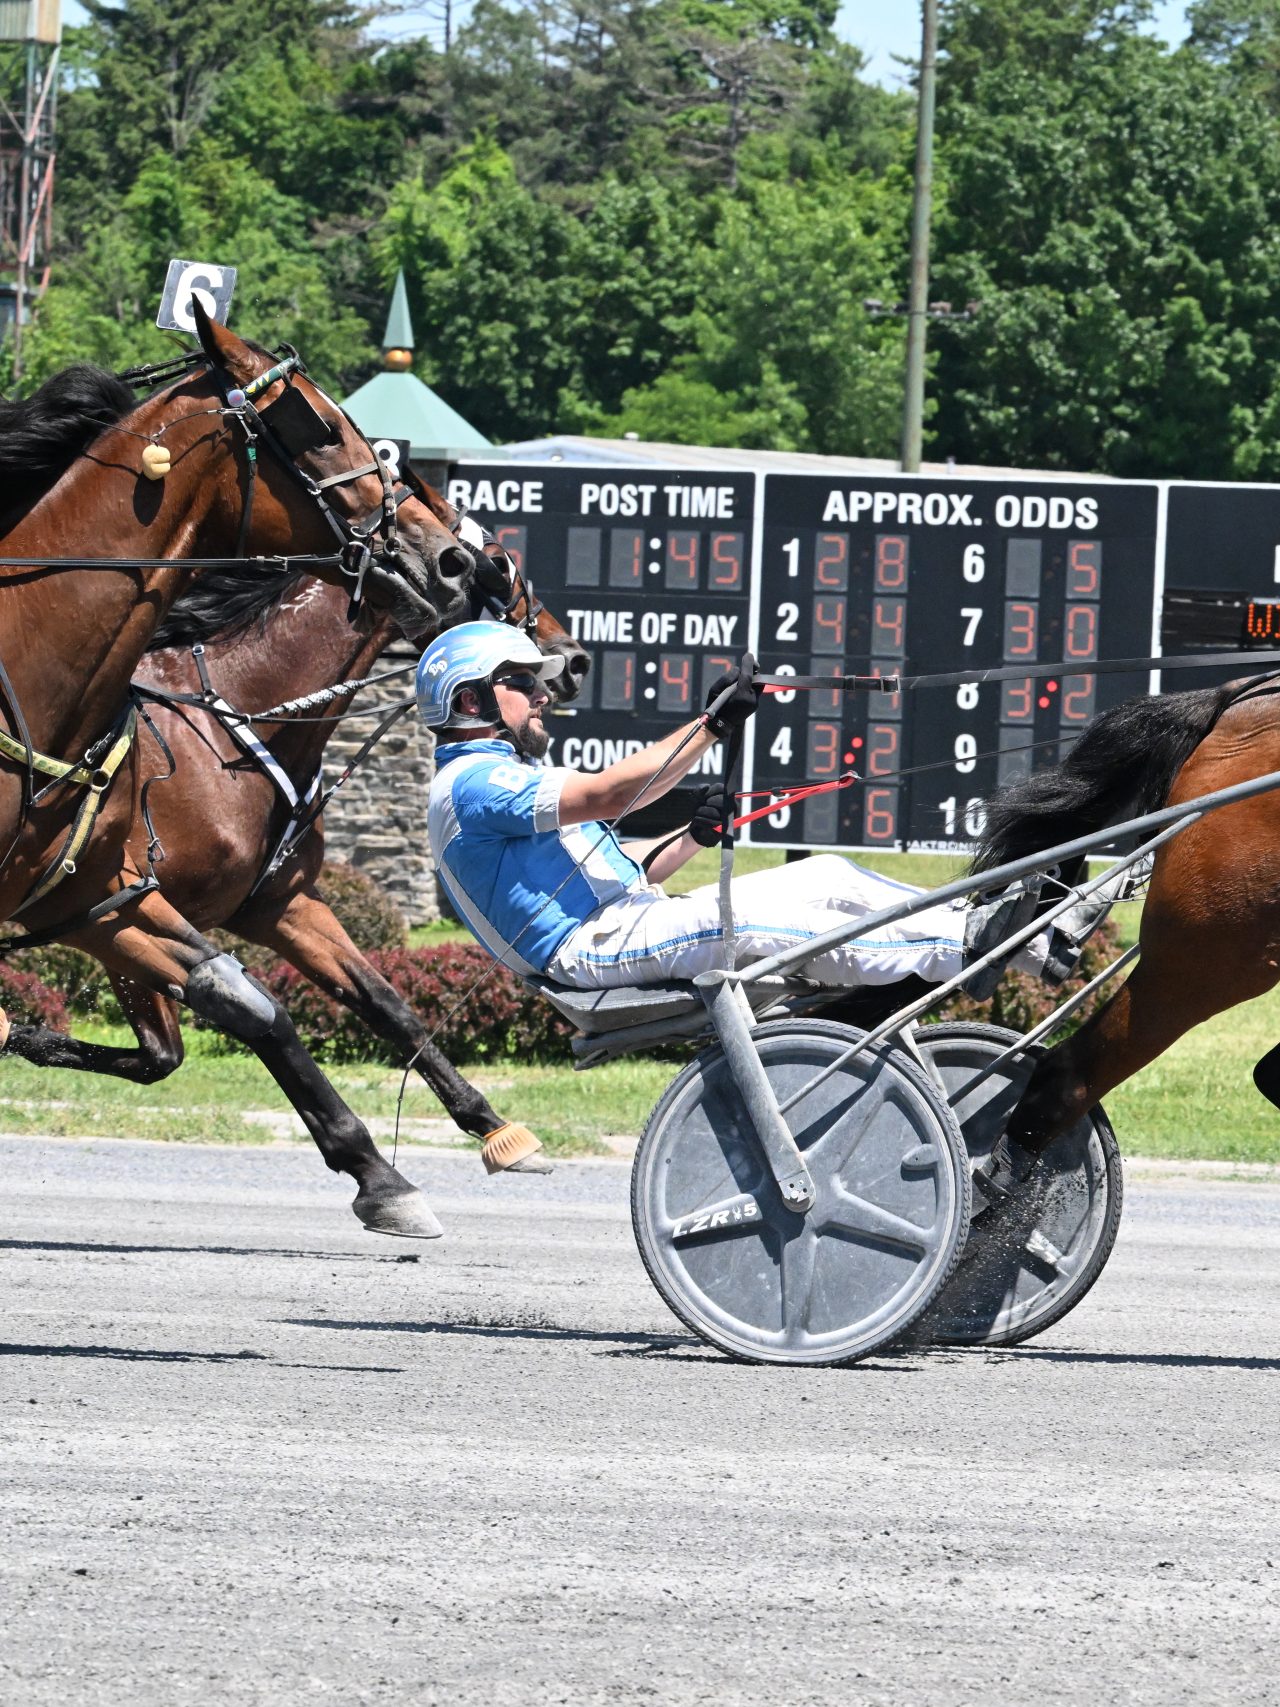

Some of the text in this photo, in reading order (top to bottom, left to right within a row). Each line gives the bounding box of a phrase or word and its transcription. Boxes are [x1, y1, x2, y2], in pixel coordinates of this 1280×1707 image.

[172, 262, 224, 332] 6
[447, 480, 543, 512] RACE
[580, 484, 734, 518] POST TIME
[822, 490, 1099, 529] APPROX. ODDS
[633, 535, 739, 584] 1:45
[782, 538, 800, 577] 1
[963, 543, 1098, 593] 6 5
[566, 610, 738, 647] TIME OF DAY
[776, 602, 799, 641] 2
[960, 608, 983, 646] 7
[956, 682, 979, 710] 8
[770, 726, 793, 765] 4
[954, 733, 977, 774] 9
[767, 789, 894, 840] 5 6
[938, 797, 989, 837] 10
